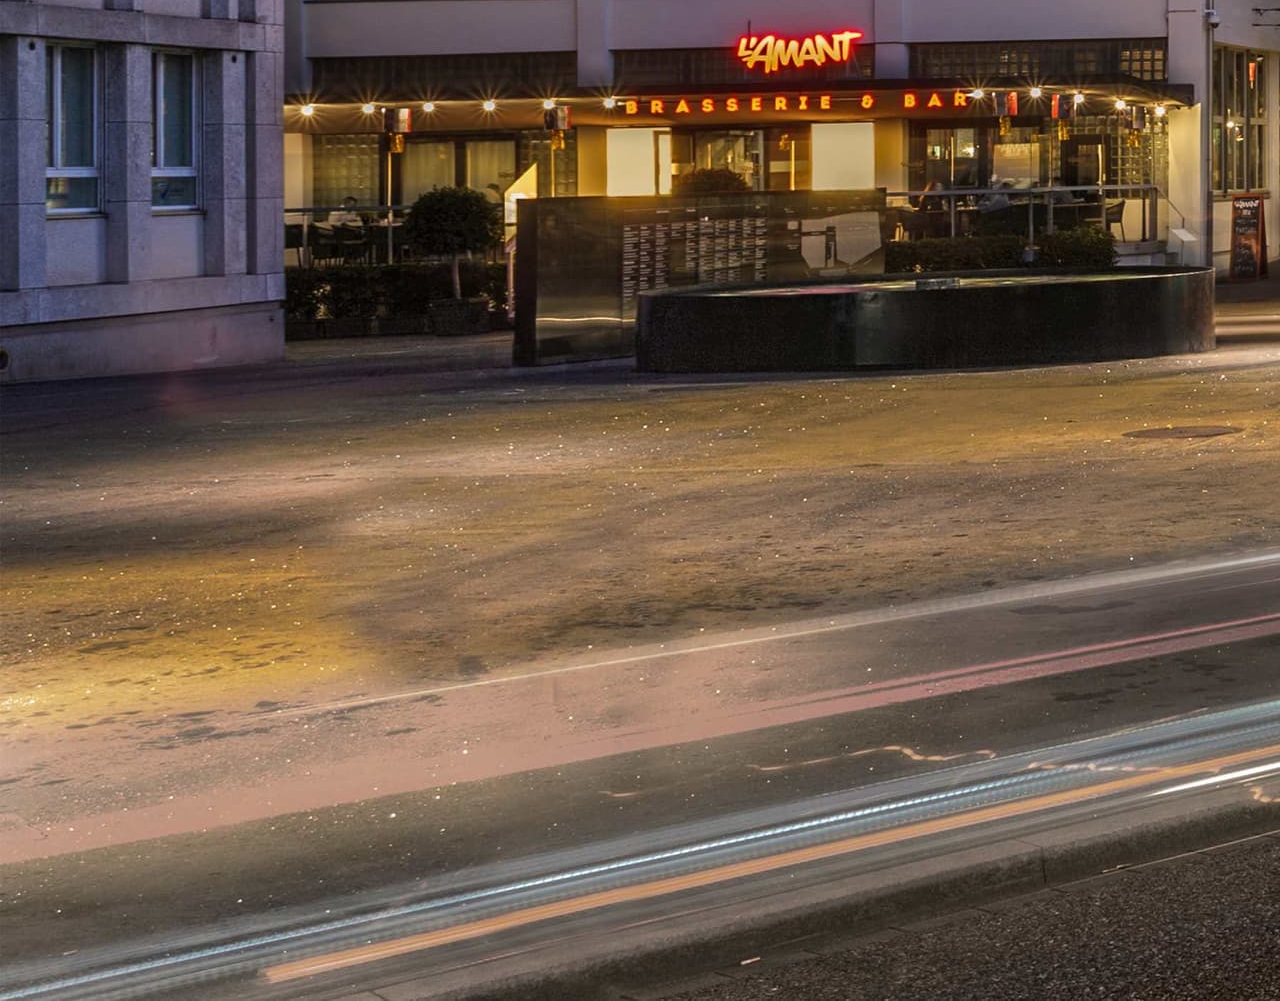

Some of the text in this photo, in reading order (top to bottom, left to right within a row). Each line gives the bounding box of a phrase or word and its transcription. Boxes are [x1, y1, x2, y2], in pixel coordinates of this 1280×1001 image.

[737, 30, 863, 74] L'AMANT
[625, 92, 967, 116] BRASSERIE & BAR
